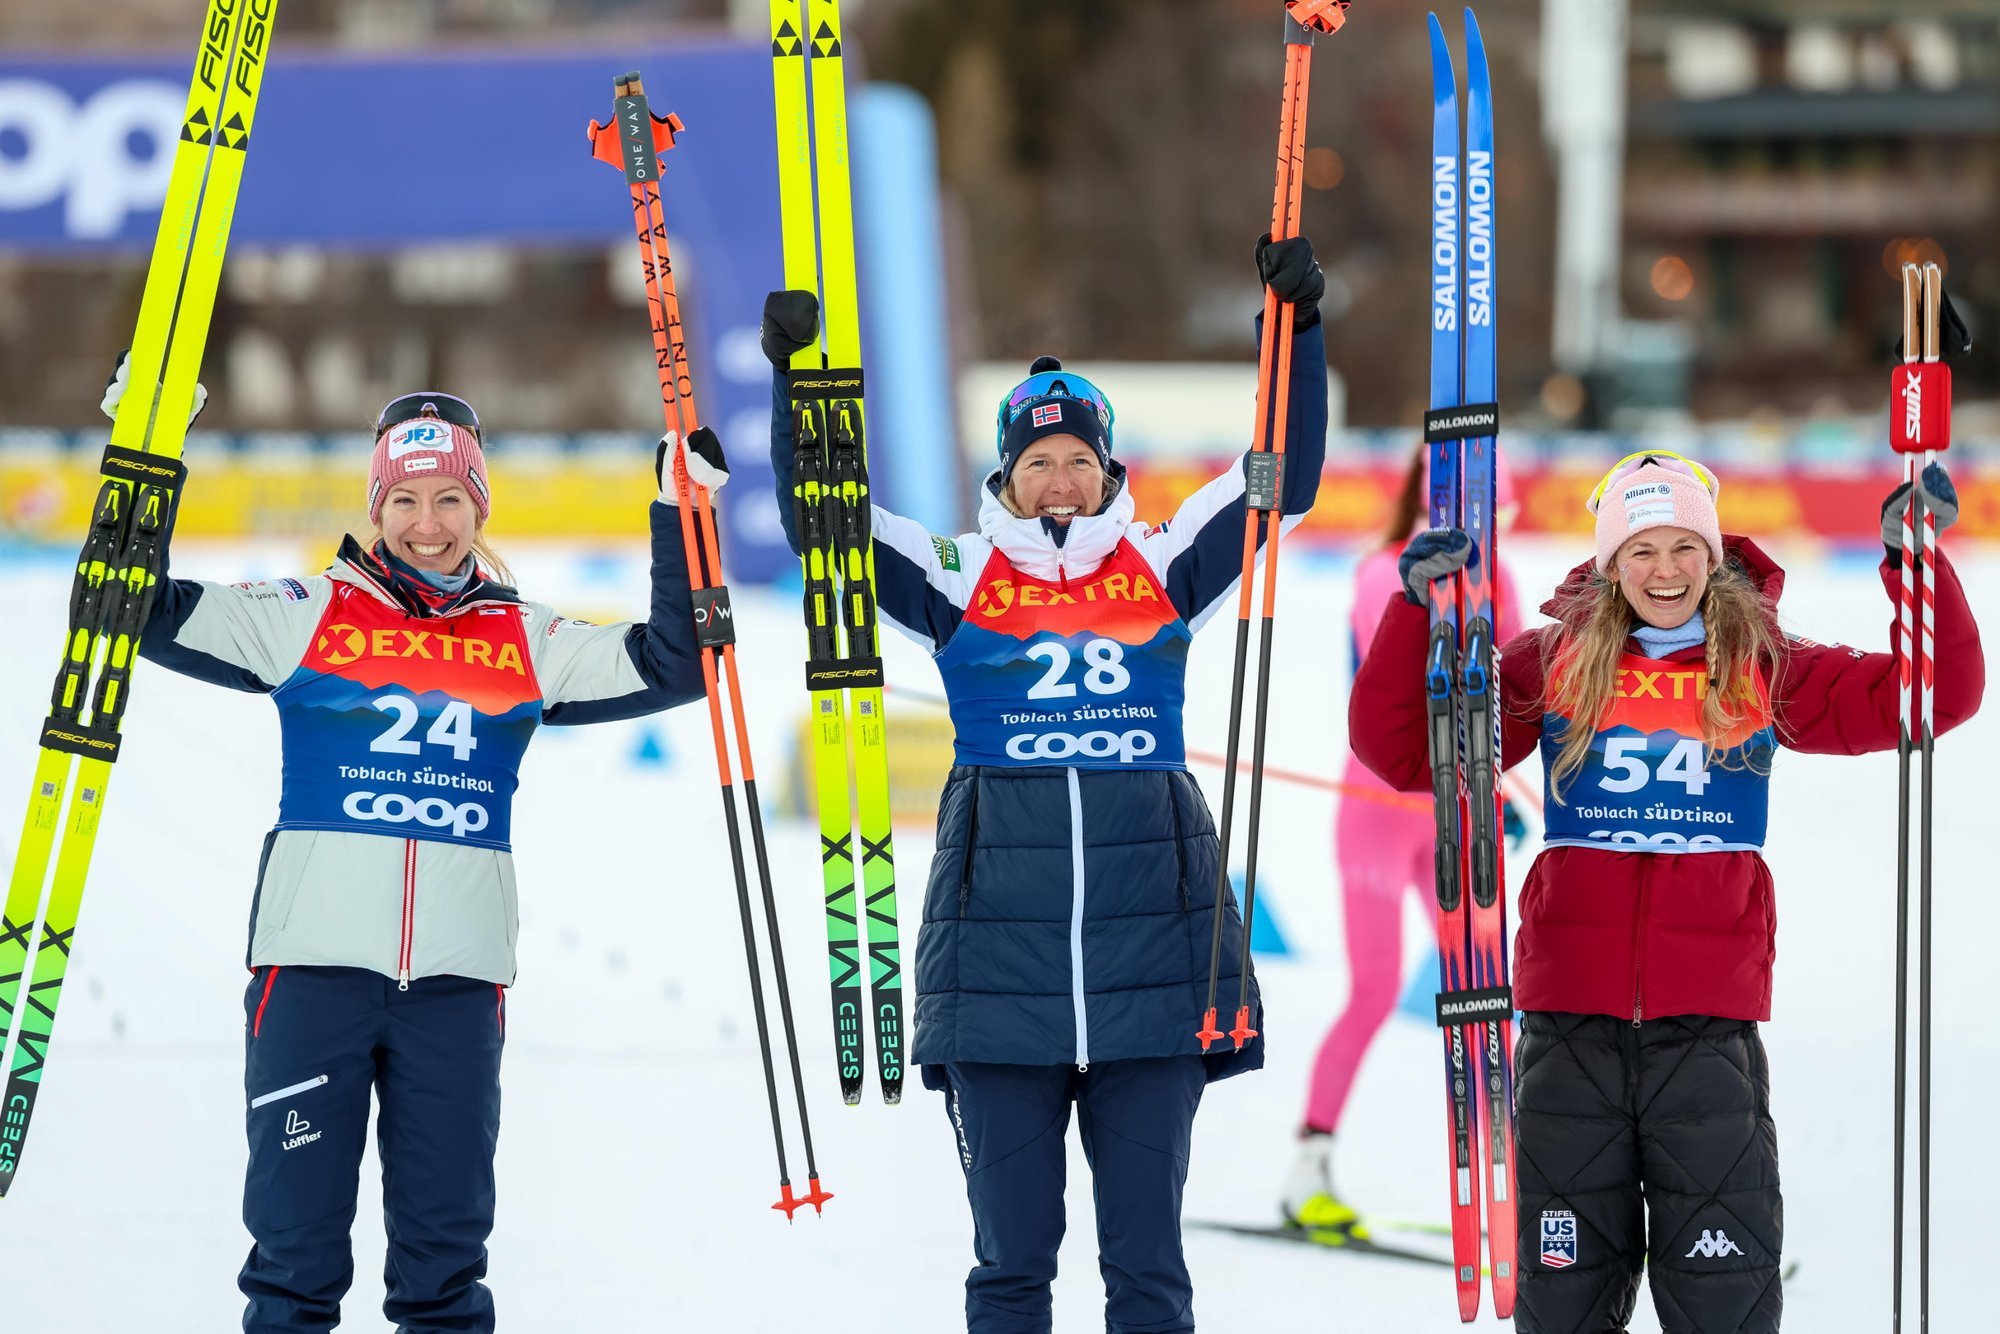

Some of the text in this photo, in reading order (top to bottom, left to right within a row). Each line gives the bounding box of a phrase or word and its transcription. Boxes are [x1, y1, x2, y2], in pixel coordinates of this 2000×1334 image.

[1435, 155, 1456, 331] SALOMON
[1469, 151, 1491, 327] SALOMON
[792, 379, 861, 389] FISCHER
[402, 428, 436, 445] JFJ
[1428, 413, 1495, 432] SALOMON
[106, 457, 177, 478] FISCHER
[1625, 486, 1656, 501] Allianz
[1019, 573, 1160, 607] EXTRA
[694, 599, 731, 629] O/W
[371, 629, 527, 677] EXTRA
[810, 668, 878, 680] FISCHER
[1025, 638, 1131, 701] 28
[369, 694, 478, 762] 24
[1000, 711, 1067, 726] Toblach
[1492, 643, 1502, 796] SALOMON
[46, 729, 117, 751] FISCHER
[1005, 729, 1157, 763] coop
[338, 765, 407, 783] Toblach
[1597, 737, 1711, 796] 54
[342, 790, 490, 838] coop
[1575, 806, 1638, 820] Toblach
[1441, 997, 1509, 1016] SALOMON
[839, 1001, 860, 1079] SPEED
[879, 1003, 901, 1081] SPEED
[0, 1093, 28, 1174] SPEED
[281, 1130, 322, 1151] Löffler
[1543, 1220, 1574, 1236] US
